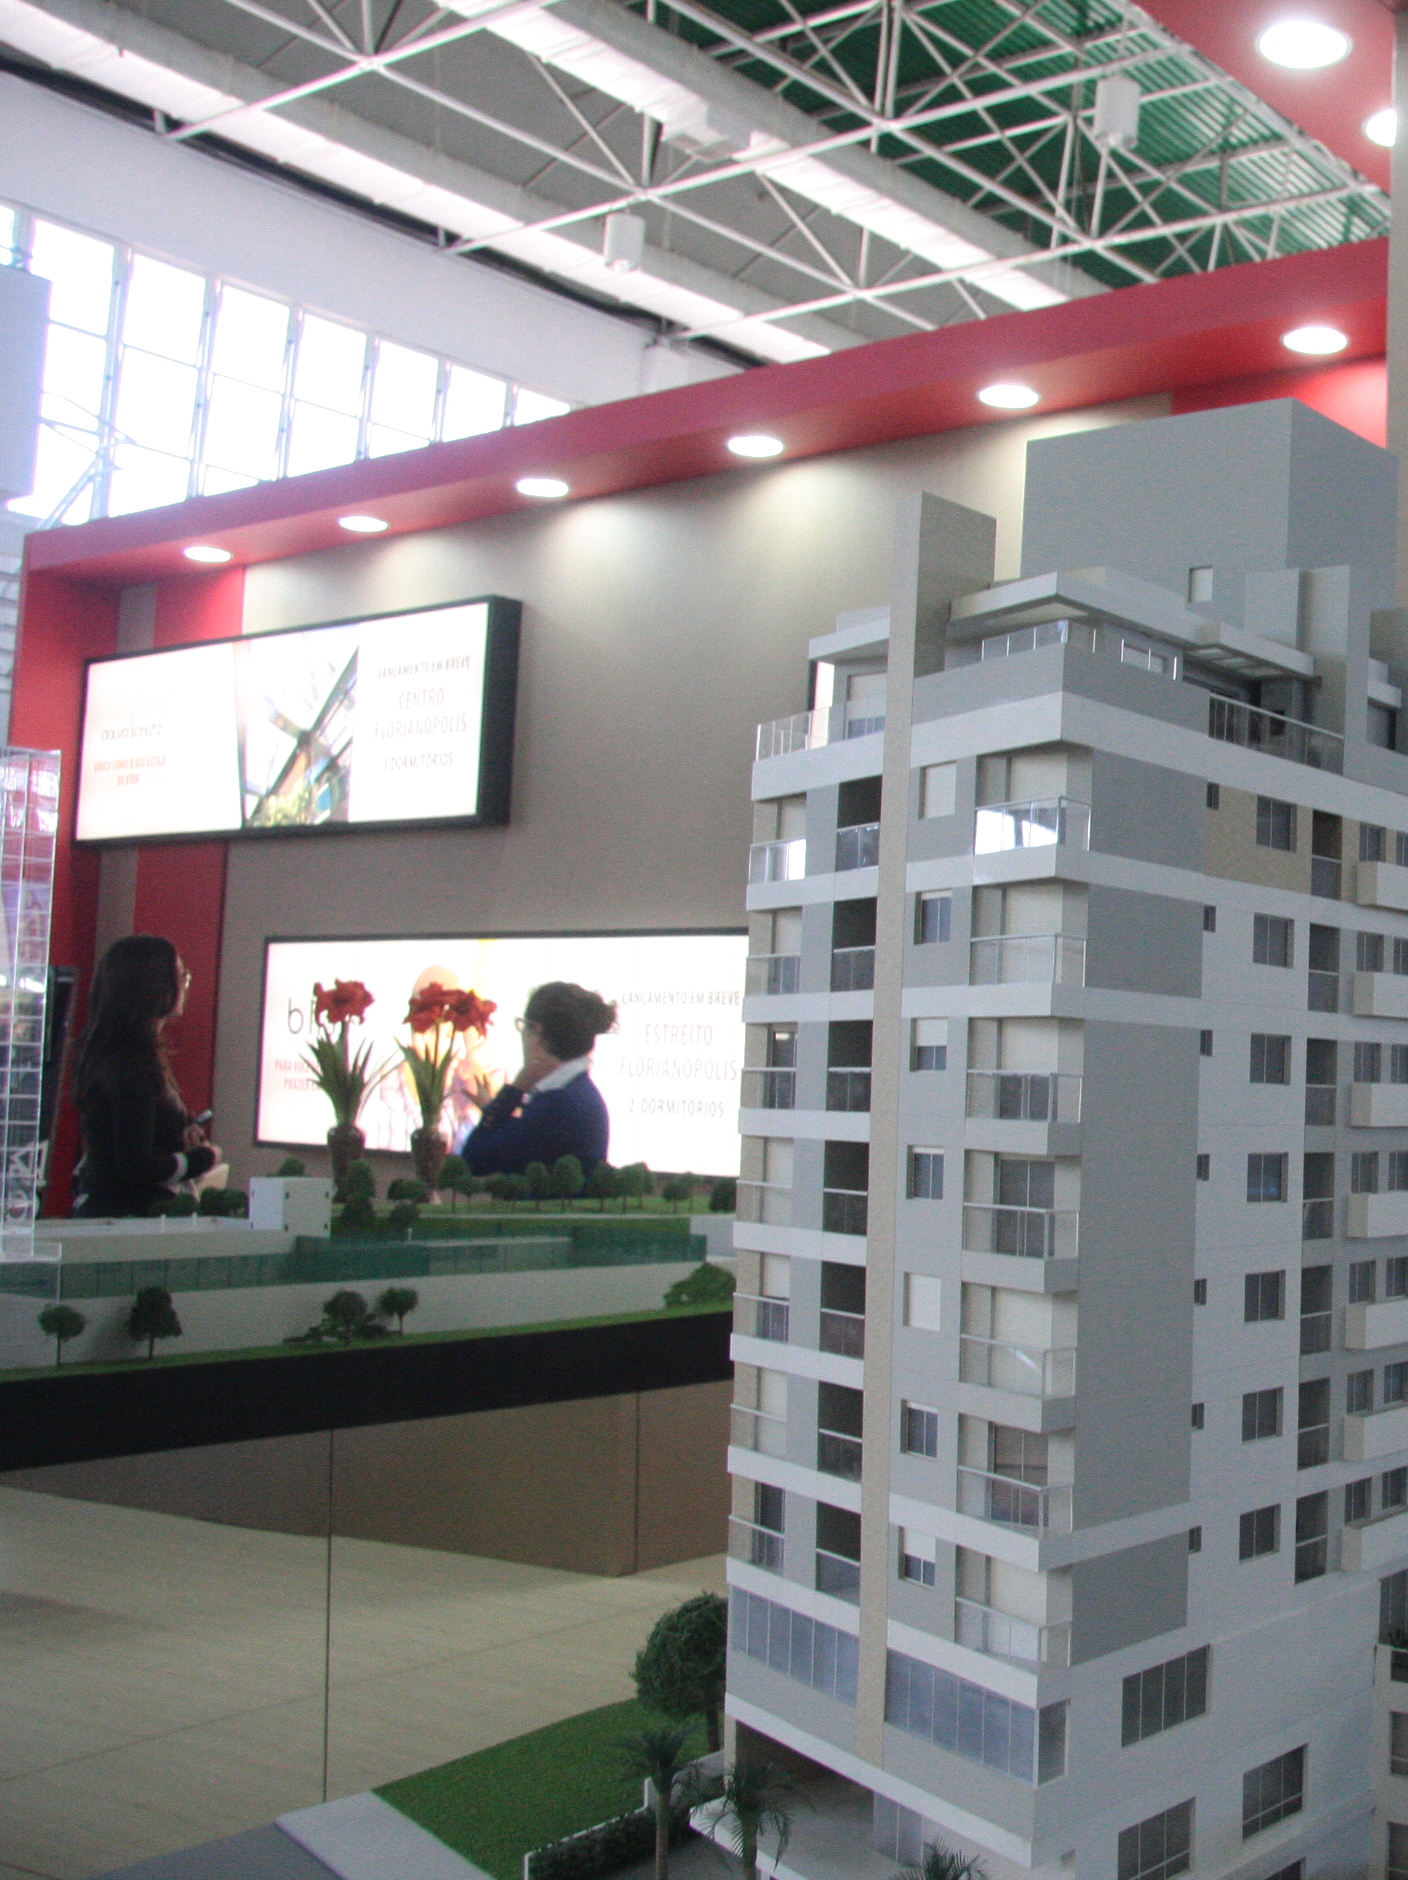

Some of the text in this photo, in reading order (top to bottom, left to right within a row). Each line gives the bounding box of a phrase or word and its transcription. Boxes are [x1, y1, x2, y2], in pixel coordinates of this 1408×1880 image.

[398, 686, 446, 710] CENTRO
[621, 990, 741, 1006] LANÇAMENTO EM BREVE
[645, 1023, 713, 1046] ESTREITO
[629, 1097, 635, 1113] 2
